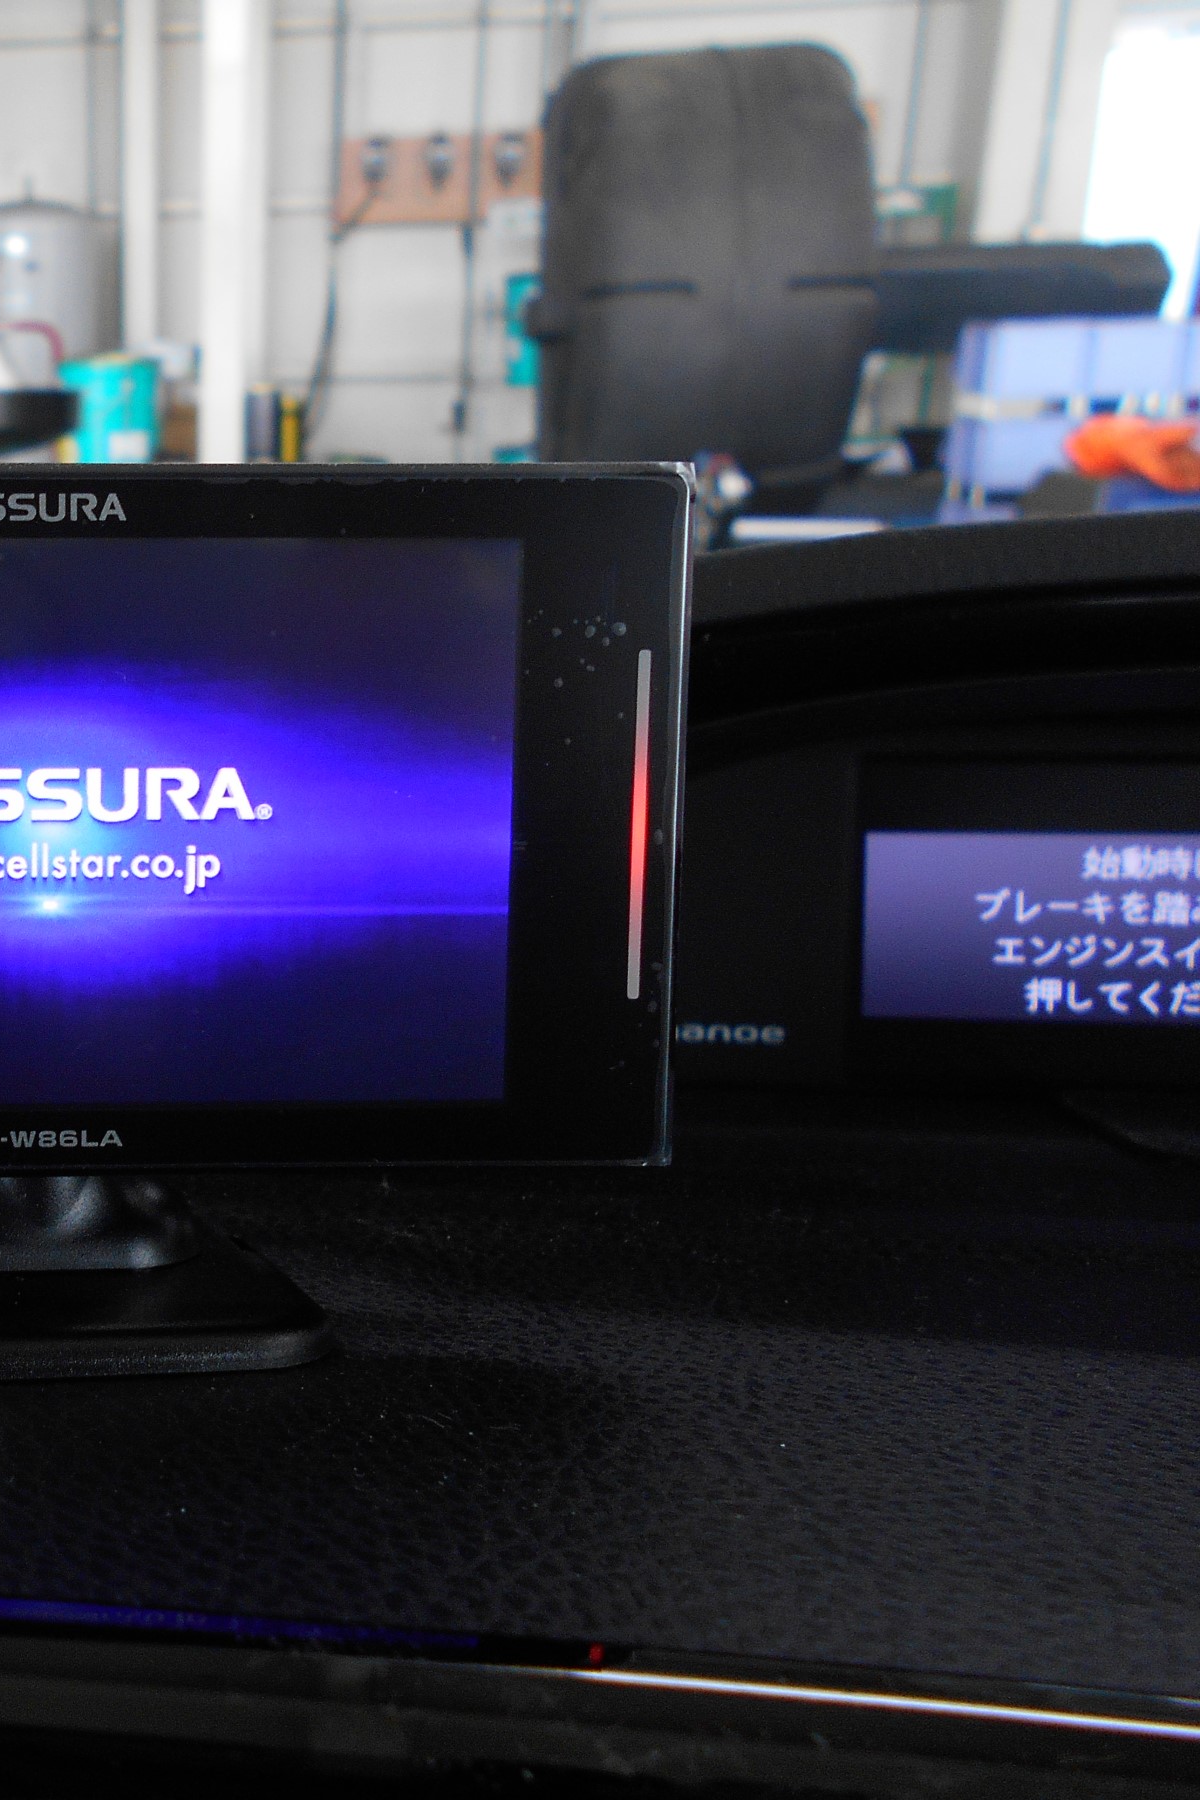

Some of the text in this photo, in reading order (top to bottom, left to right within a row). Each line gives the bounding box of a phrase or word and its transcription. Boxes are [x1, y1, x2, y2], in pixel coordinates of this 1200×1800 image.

[1081, 845, 1200, 881] 始動時
[675, 1023, 786, 1043] anoe
